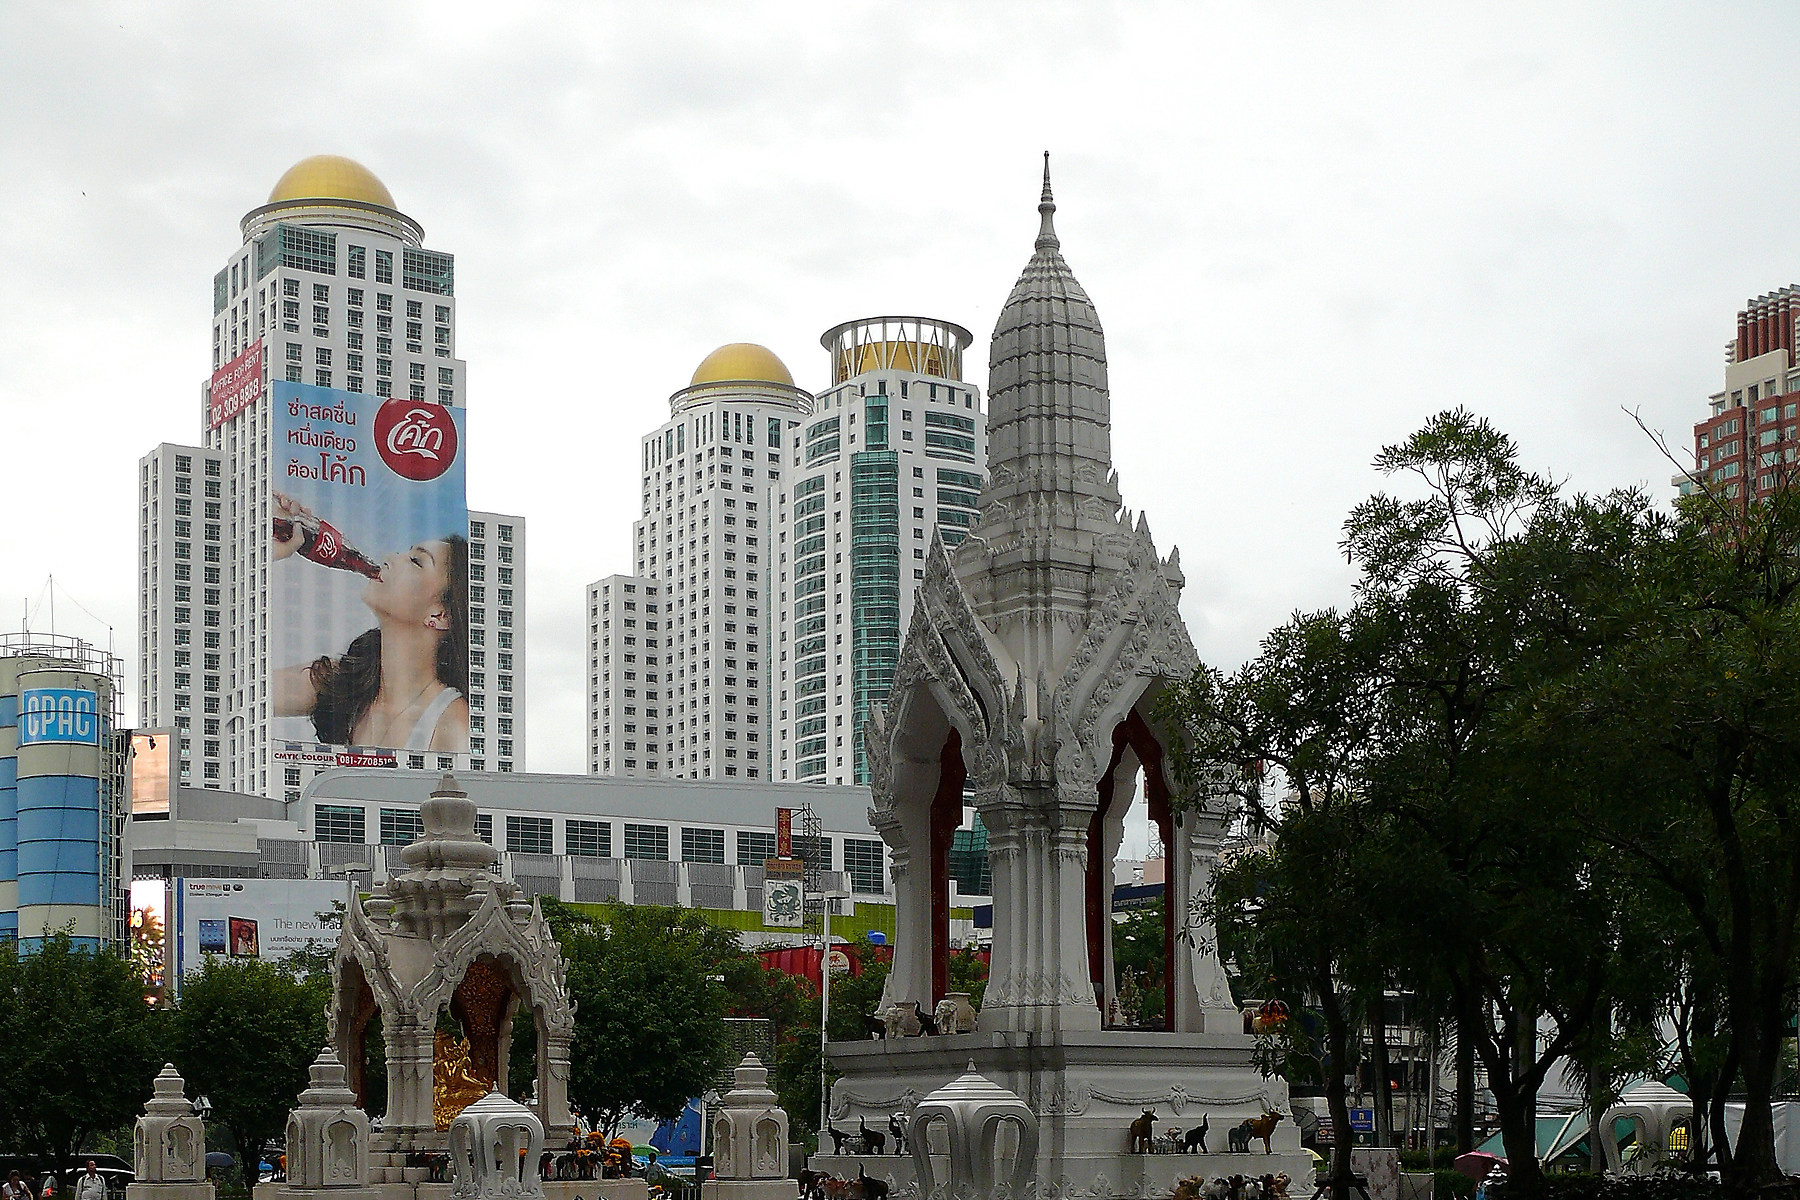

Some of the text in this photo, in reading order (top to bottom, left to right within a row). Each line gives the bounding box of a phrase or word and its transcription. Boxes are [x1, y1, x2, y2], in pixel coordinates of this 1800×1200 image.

[287, 398, 357, 426] ซ่าสดชื่น
[287, 423, 357, 452] หนึ่งเดียว
[28, 695, 90, 737] CPAC
[274, 752, 335, 763] CMYK COLOUR
[273, 918, 293, 930] The
[295, 920, 318, 930] new
